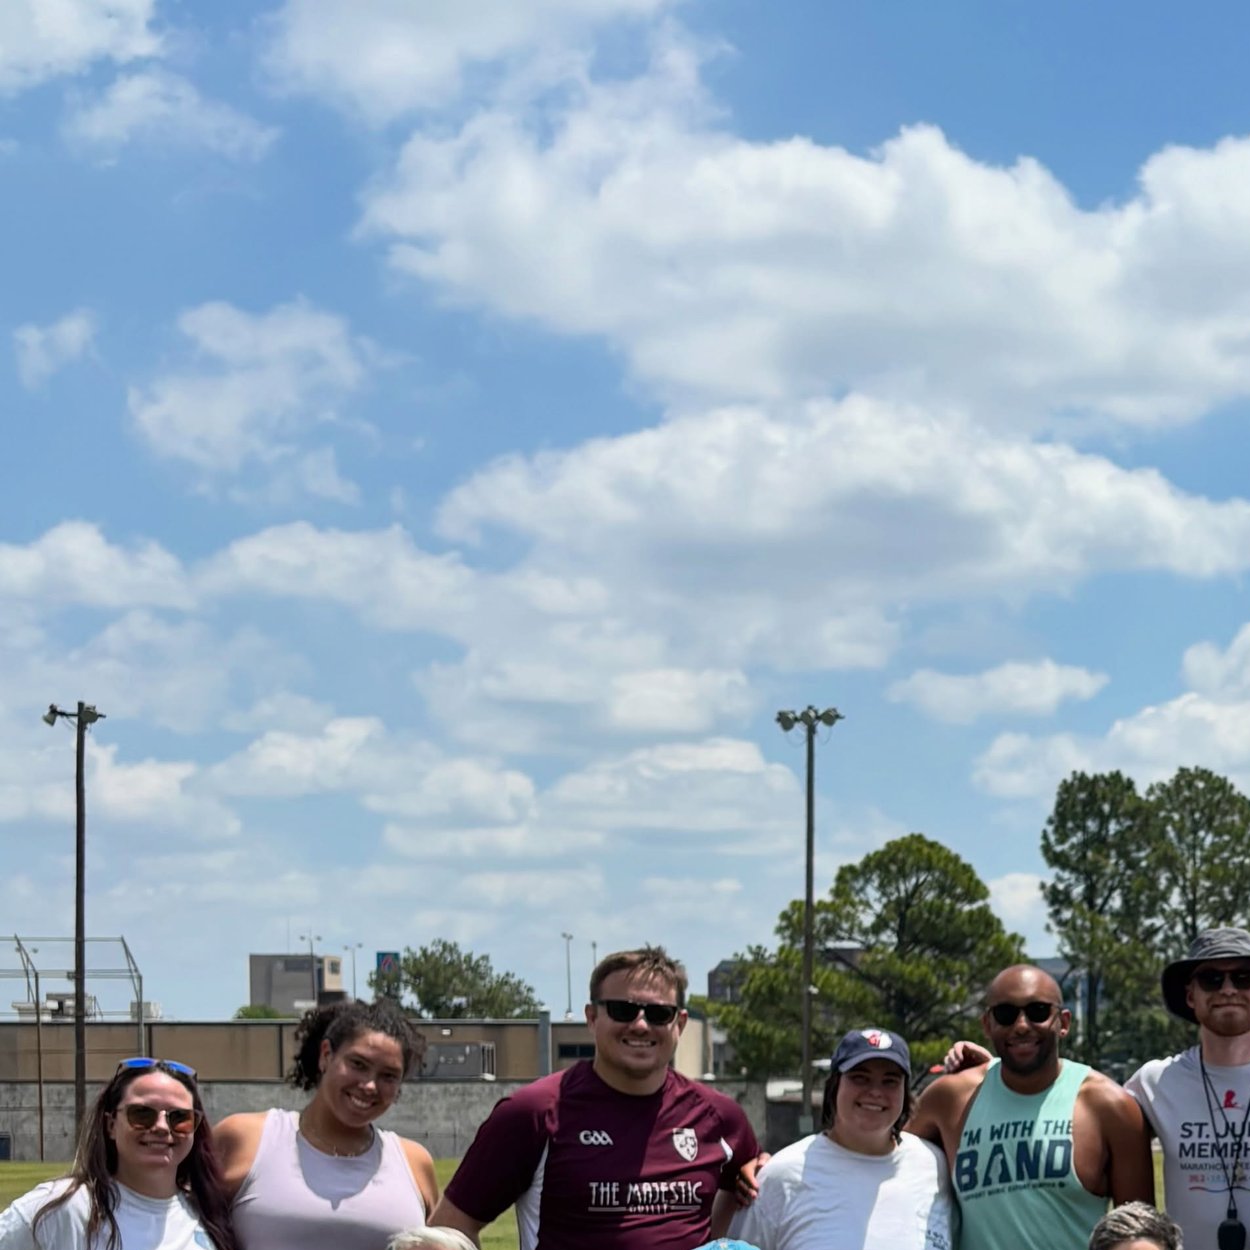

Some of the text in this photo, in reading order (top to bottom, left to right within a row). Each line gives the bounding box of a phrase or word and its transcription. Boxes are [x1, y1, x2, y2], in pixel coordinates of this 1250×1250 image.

[579, 1130, 614, 1145] GAA
[990, 1120, 1035, 1141] WITH
[1043, 1120, 1073, 1135] THE
[1180, 1121, 1210, 1138] ST.
[955, 1139, 1073, 1193] BAND
[589, 1181, 703, 1206] THE MAJESTIC
